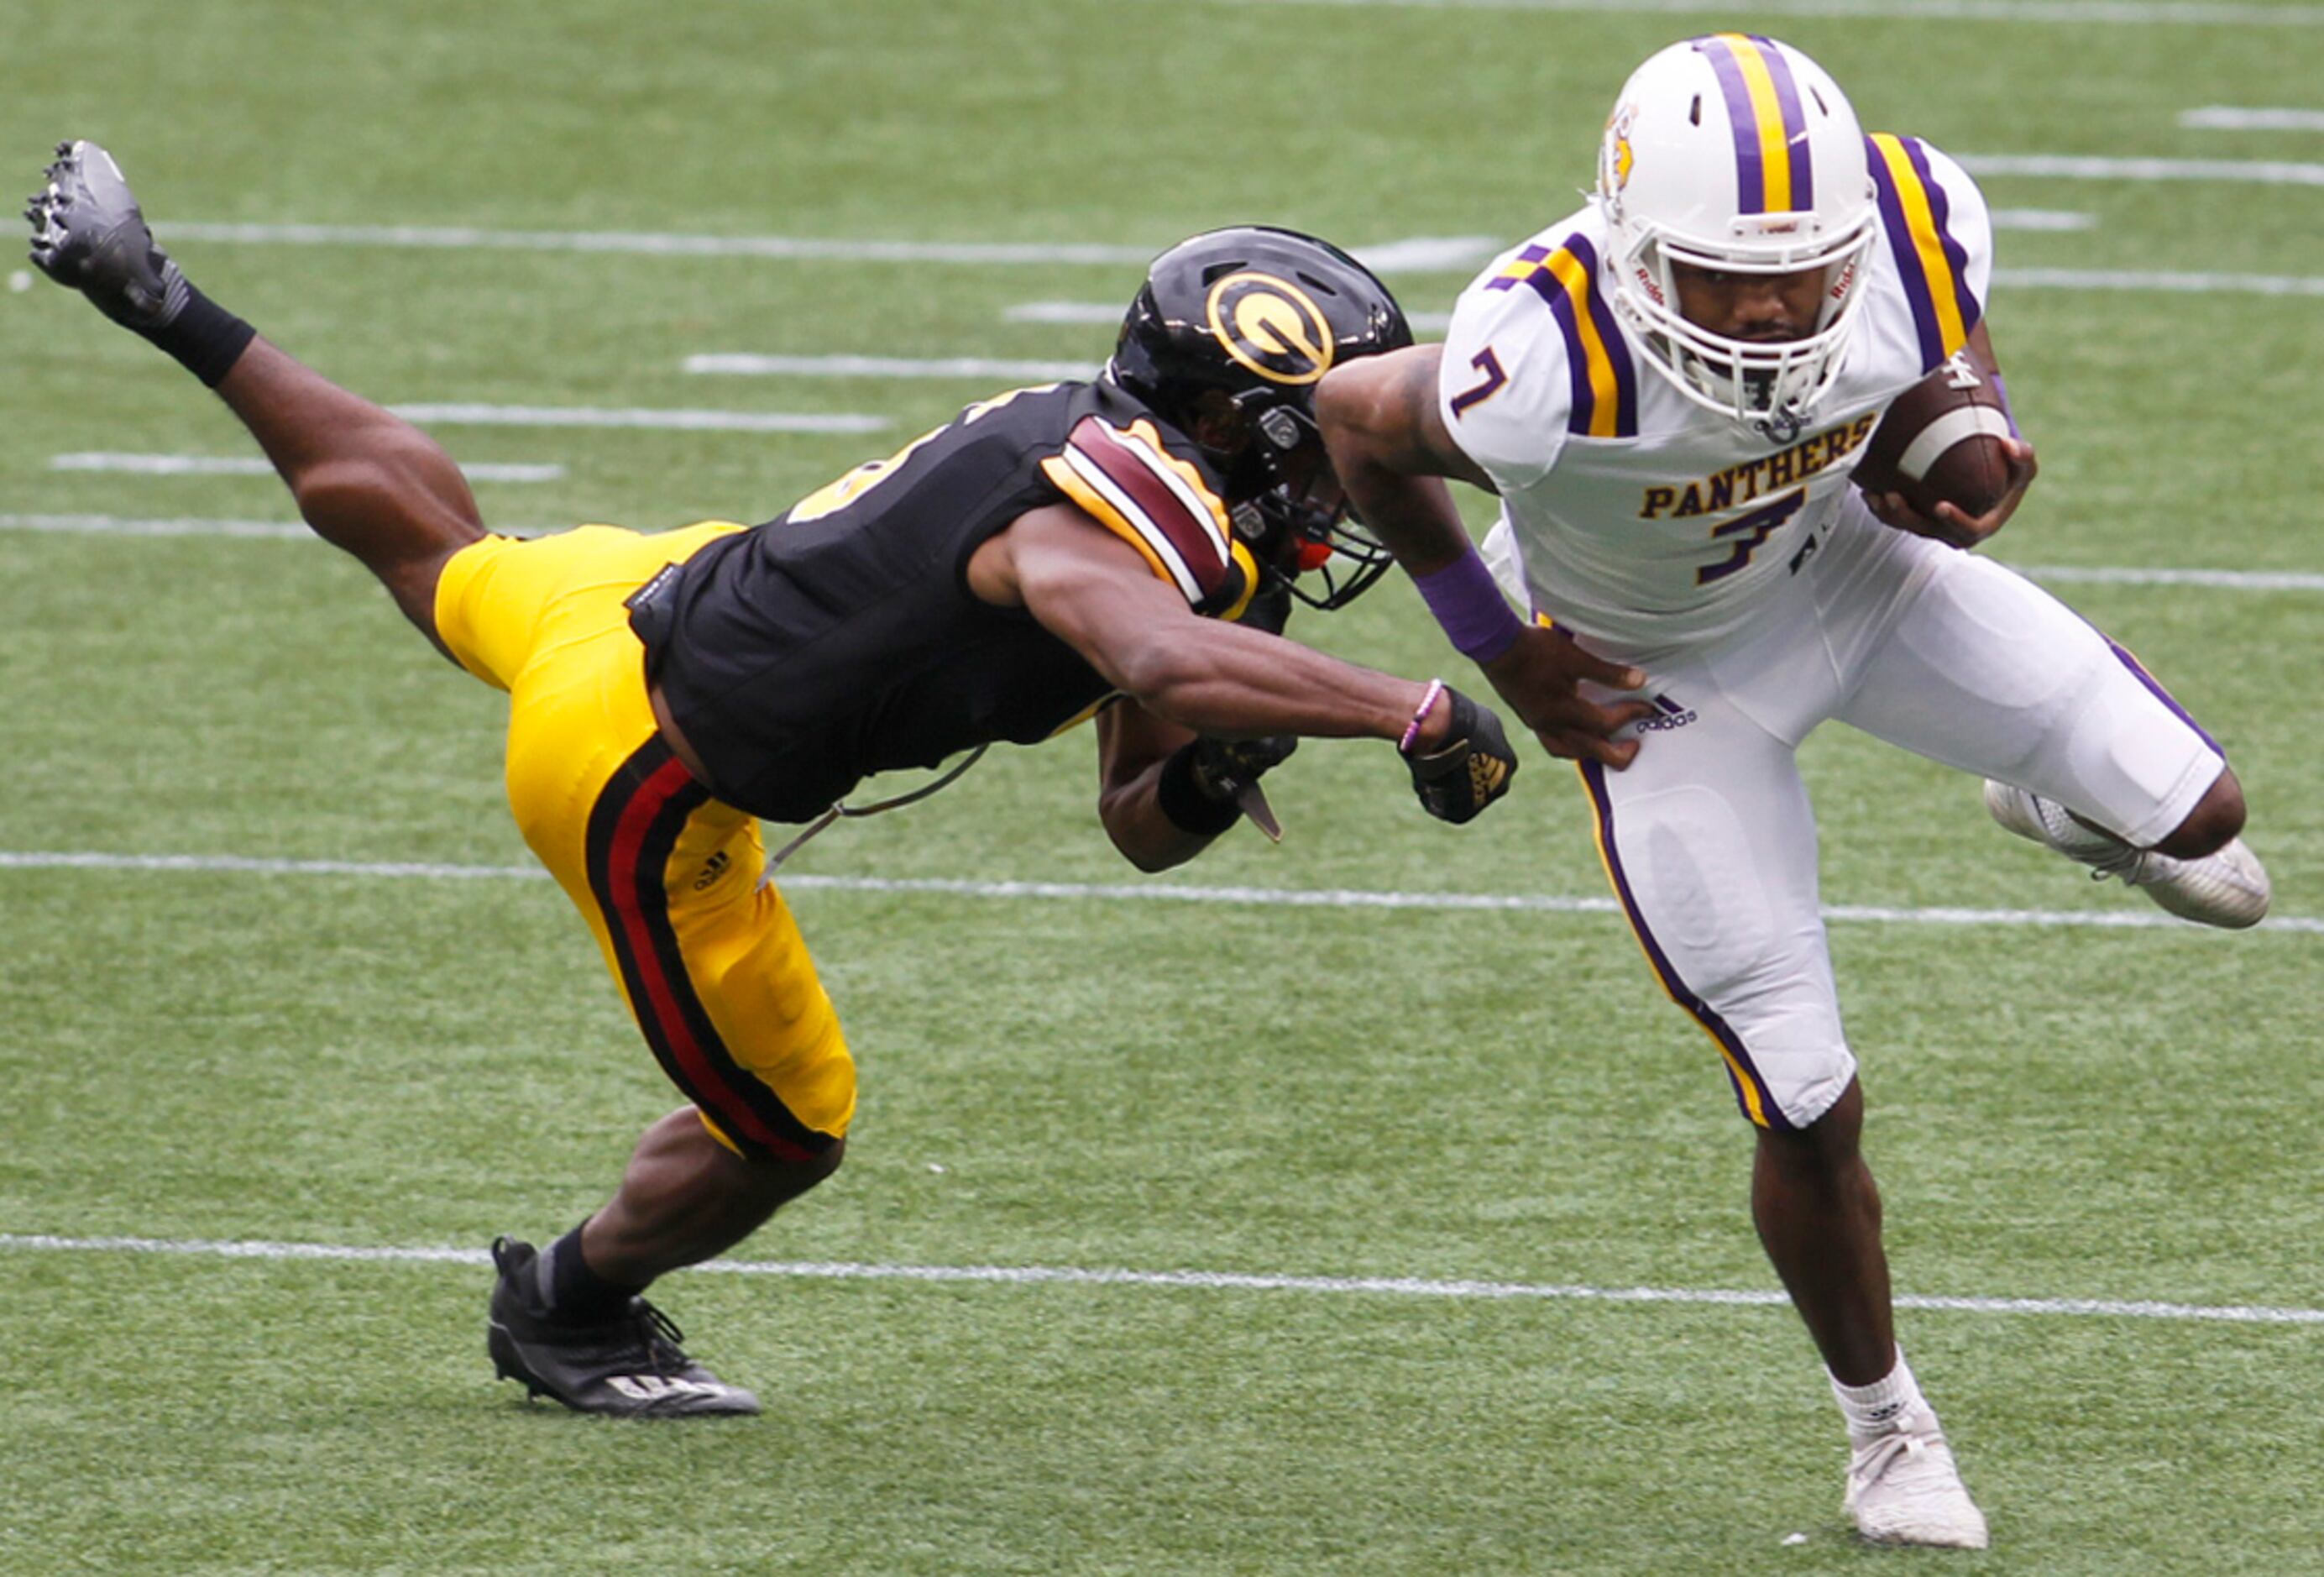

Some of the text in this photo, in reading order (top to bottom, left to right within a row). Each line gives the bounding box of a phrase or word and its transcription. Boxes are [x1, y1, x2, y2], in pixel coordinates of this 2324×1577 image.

[1234, 291, 1333, 372] G
[1450, 345, 1508, 420] 7
[1639, 410, 1879, 519] PANTHERS
[1695, 482, 1807, 586] 7
